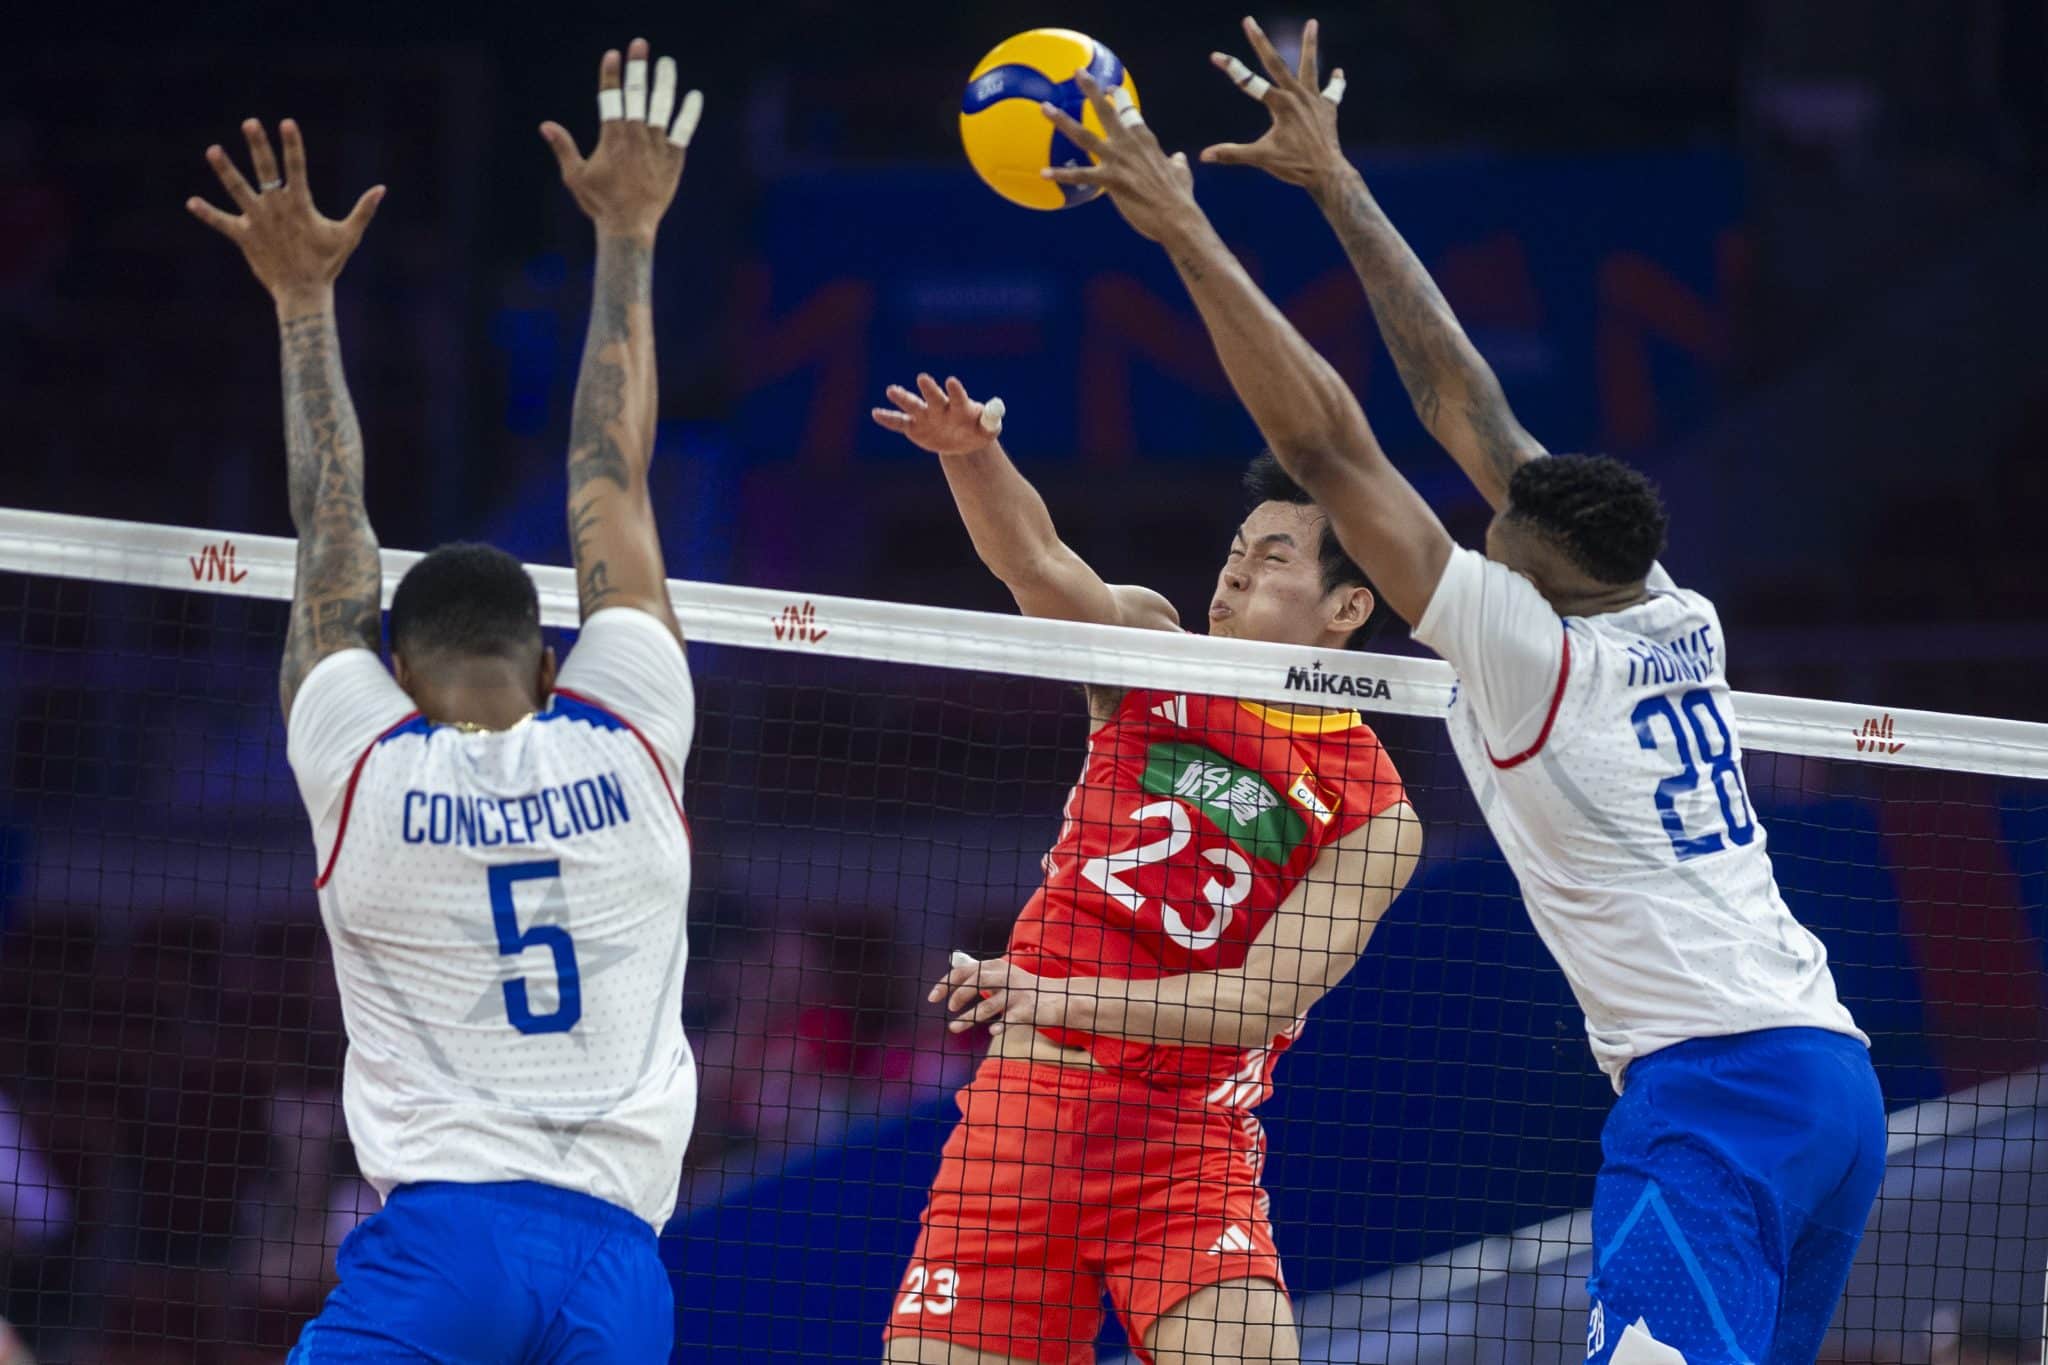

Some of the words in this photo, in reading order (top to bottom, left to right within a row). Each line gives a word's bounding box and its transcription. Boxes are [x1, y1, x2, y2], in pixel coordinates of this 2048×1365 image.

[189, 540, 247, 584] VNL
[771, 600, 827, 644] VNL
[1852, 713, 1905, 754] VNL
[1630, 688, 1755, 862] 28
[402, 771, 631, 848] CONCEPCION
[1080, 800, 1251, 951] 23
[486, 858, 582, 1036] 5
[897, 1265, 960, 1316] 23
[1586, 1299, 1605, 1360] 28
